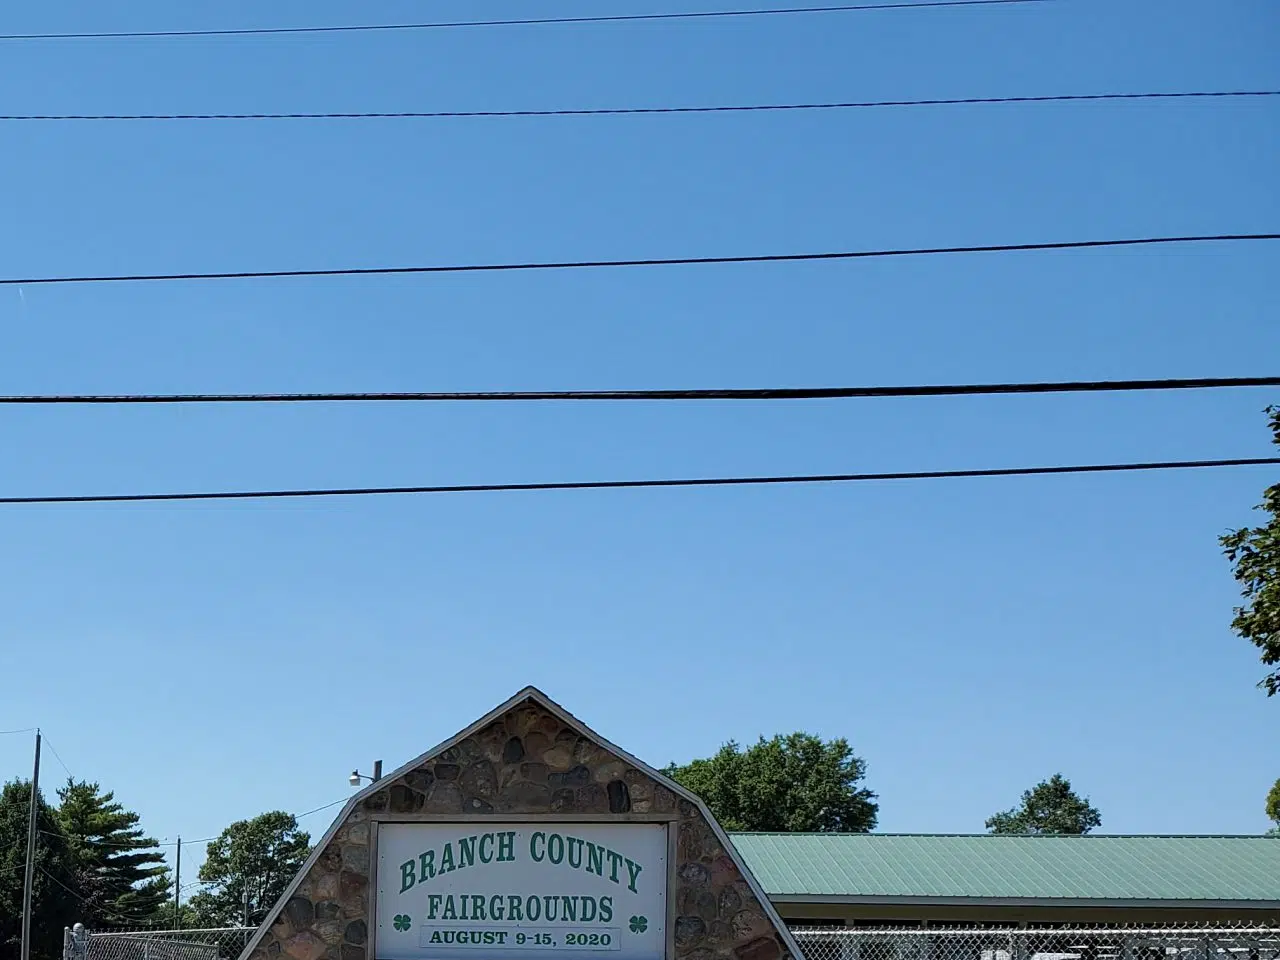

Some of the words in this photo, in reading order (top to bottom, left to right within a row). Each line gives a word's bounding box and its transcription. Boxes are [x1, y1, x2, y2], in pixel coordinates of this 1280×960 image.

[399, 831, 517, 894] BRANCH
[529, 831, 643, 894] COUNTY
[427, 894, 613, 922] FAIRGROUNDS
[429, 931, 508, 945] AUGUST
[515, 931, 557, 947] 9-15,
[565, 933, 611, 946] 2020
